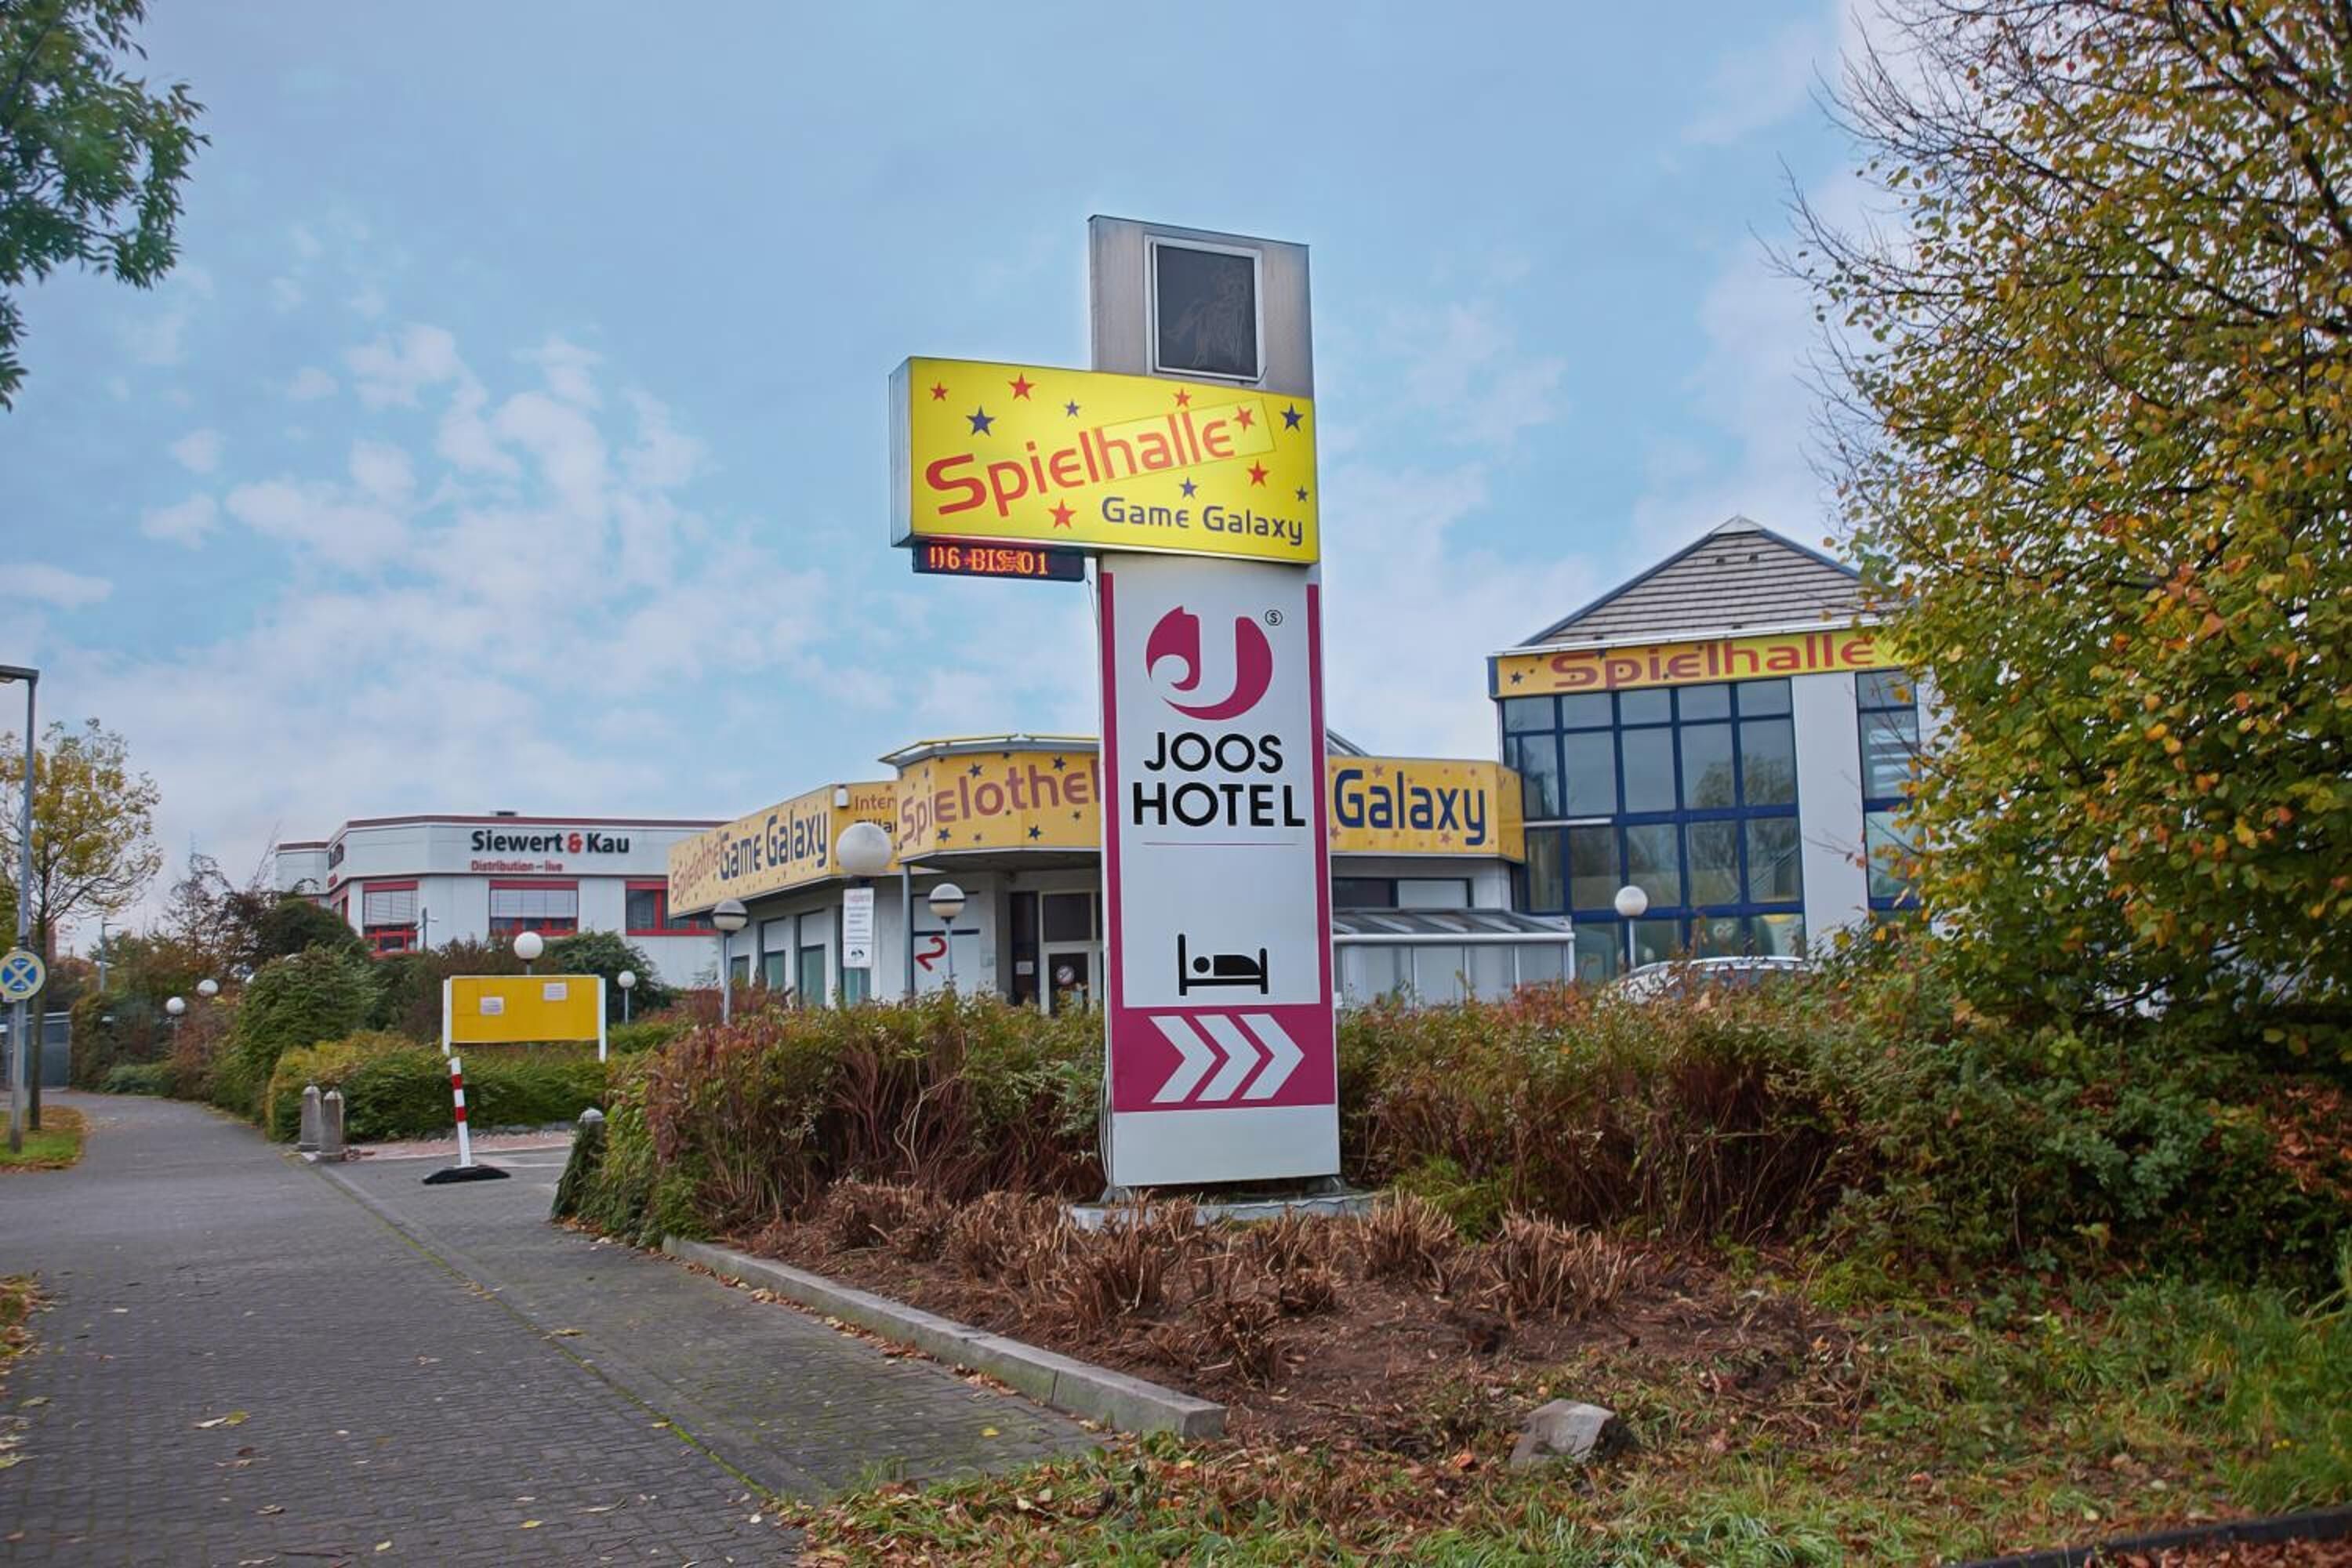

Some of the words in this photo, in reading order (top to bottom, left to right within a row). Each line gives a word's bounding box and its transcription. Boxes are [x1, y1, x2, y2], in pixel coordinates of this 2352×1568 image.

[925, 411, 1235, 517] Spielhalle
[1102, 496, 1189, 528] Game
[1203, 505, 1304, 546] Galaxy
[1549, 632, 1875, 688] Spielhalle
[1144, 731, 1283, 774] JOOS
[1133, 782, 1306, 827] HOTEL
[1334, 769, 1486, 846] Galaxy
[471, 830, 563, 852] Siewert
[568, 833, 583, 854] &
[586, 833, 630, 854] Kau
[471, 859, 534, 872] Distribution
[545, 859, 563, 872] live
[719, 831, 761, 880] Game
[766, 808, 828, 868] Galaxy
